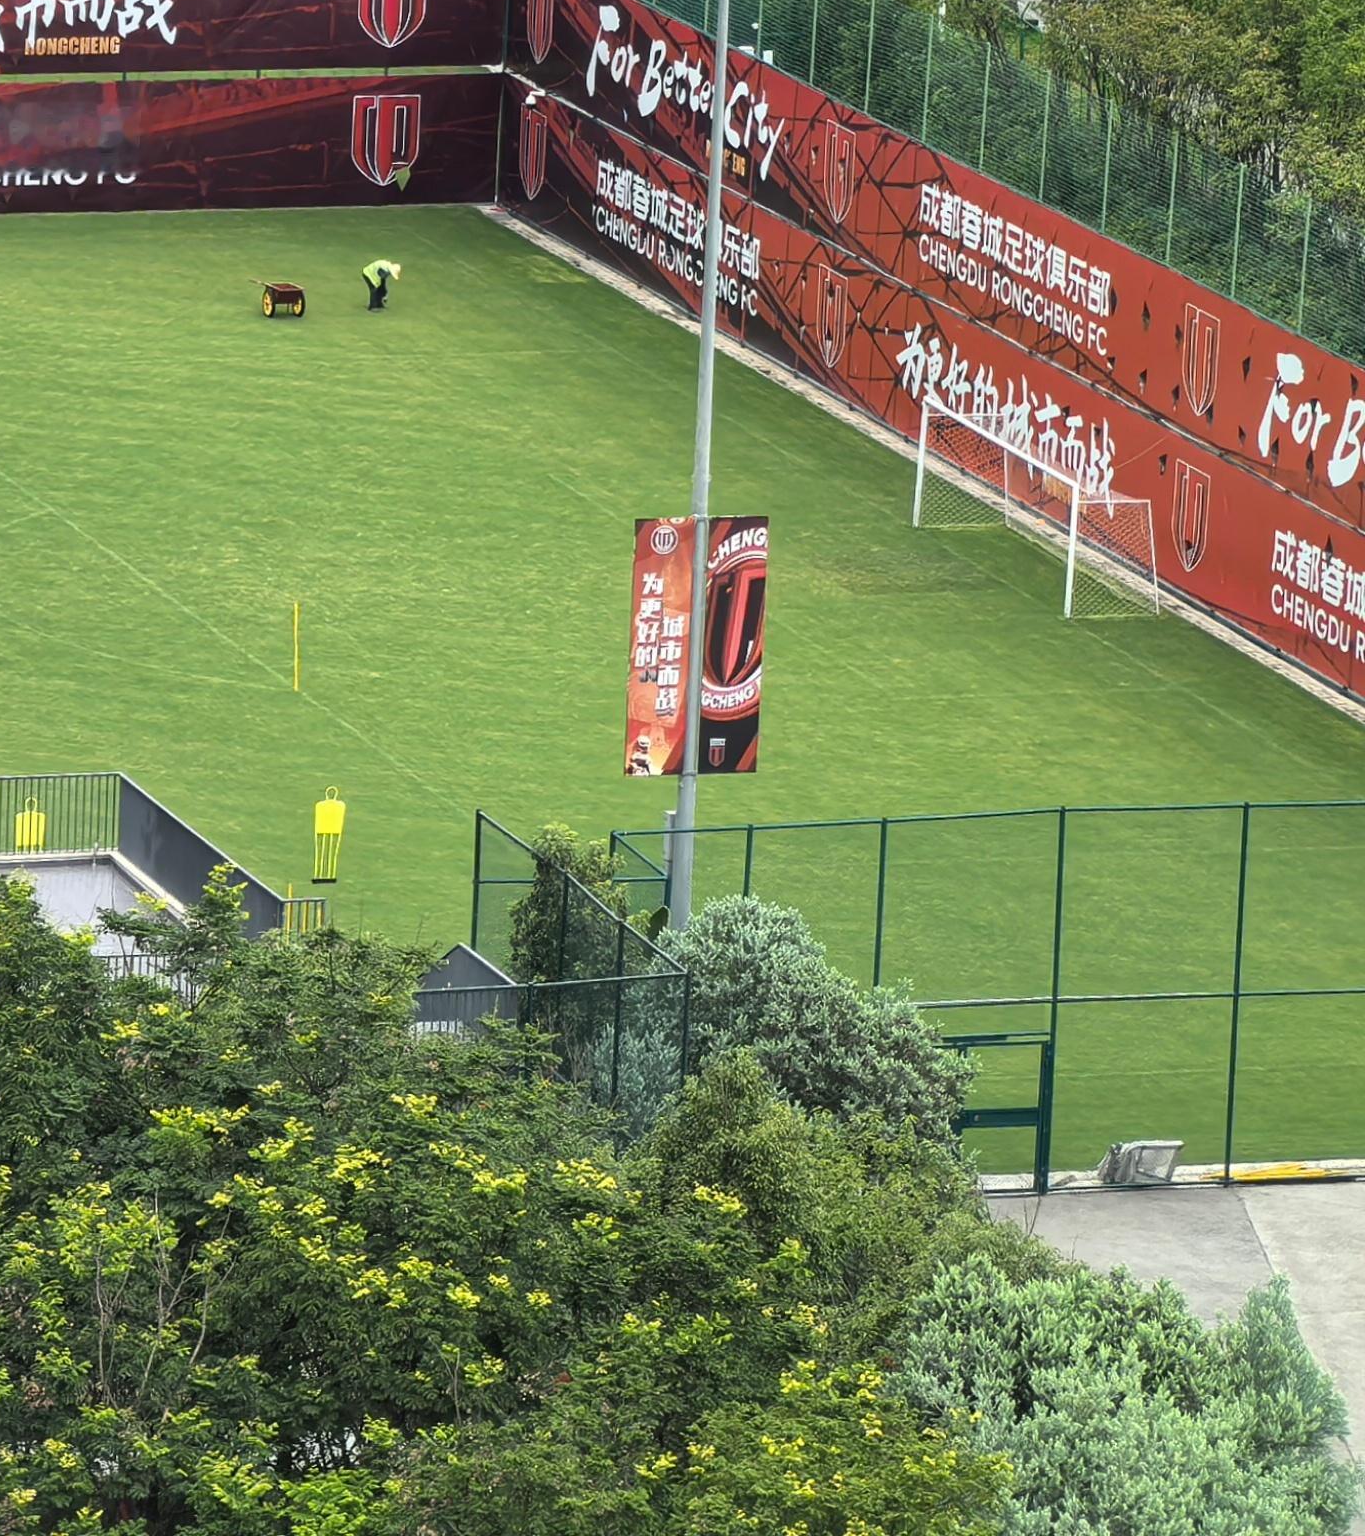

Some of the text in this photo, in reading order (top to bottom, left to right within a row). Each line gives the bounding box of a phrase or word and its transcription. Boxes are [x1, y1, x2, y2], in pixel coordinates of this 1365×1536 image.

[586, 5, 785, 182] For Bette City
[595, 207, 656, 260] CHENGDU
[596, 158, 761, 281] 成都蓉城足球乐部
[919, 182, 1111, 317] 成都蓉城足球俱乐部
[918, 233, 1108, 356] CHENGDU RONGCHENG FC
[1257, 351, 1331, 458] For
[634, 572, 664, 668] 为更好的
[655, 615, 685, 711] 城市而战
[1271, 583, 1350, 654] CHENGDU
